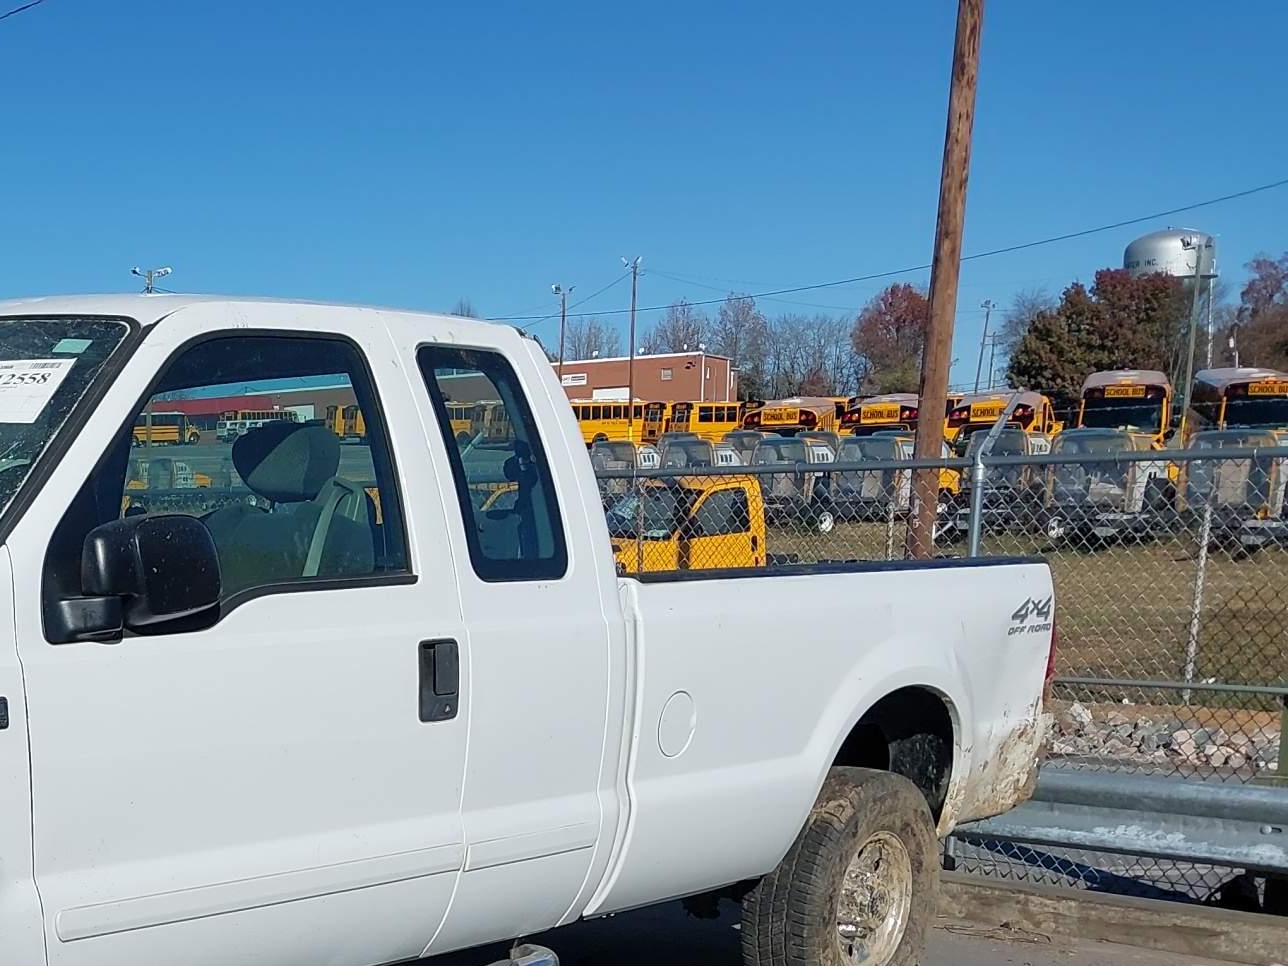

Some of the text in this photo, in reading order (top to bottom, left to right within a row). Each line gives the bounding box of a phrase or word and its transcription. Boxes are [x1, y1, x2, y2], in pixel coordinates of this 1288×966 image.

[1132, 388, 1145, 396] BUS
[1249, 384, 1288, 393] SCHOOL BU
[763, 410, 797, 421] SCHOOL BUS
[862, 410, 884, 420] SCHOOL
[972, 408, 995, 417] SCHOOL
[1008, 623, 1052, 636] OFF ROAD
